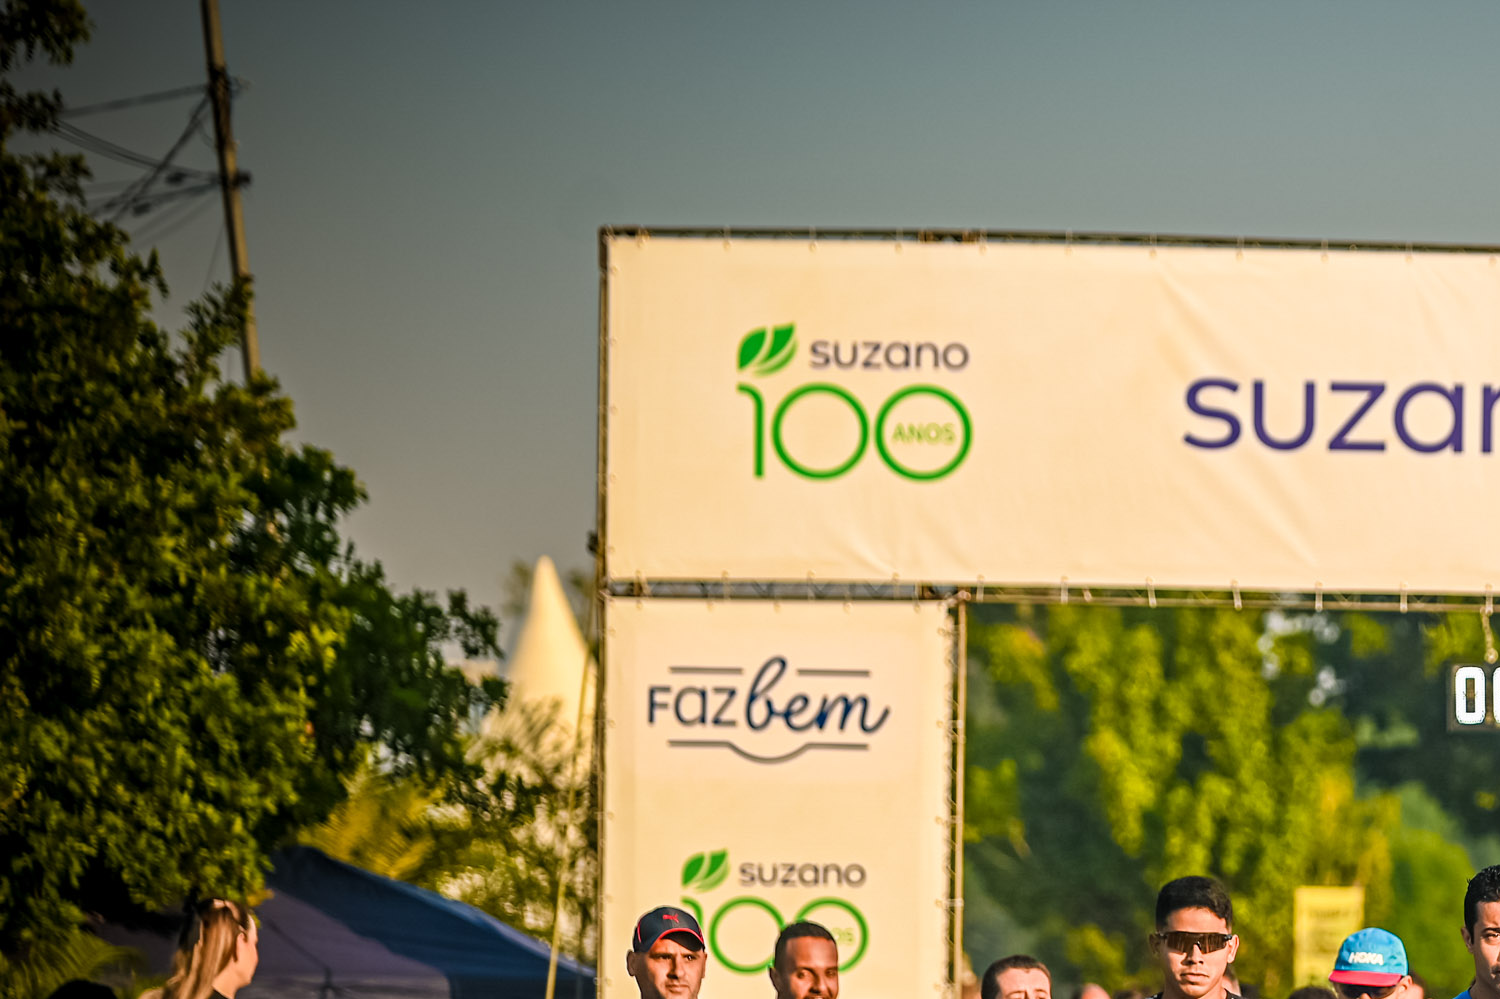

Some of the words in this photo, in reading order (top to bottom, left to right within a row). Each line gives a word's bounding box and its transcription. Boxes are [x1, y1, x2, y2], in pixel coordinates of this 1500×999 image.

[809, 339, 970, 372] suzano
[737, 382, 973, 481] 100
[892, 423, 956, 445] ANOS
[744, 654, 891, 734] bem
[738, 861, 867, 887] suzano
[1348, 951, 1384, 965] HOKA
